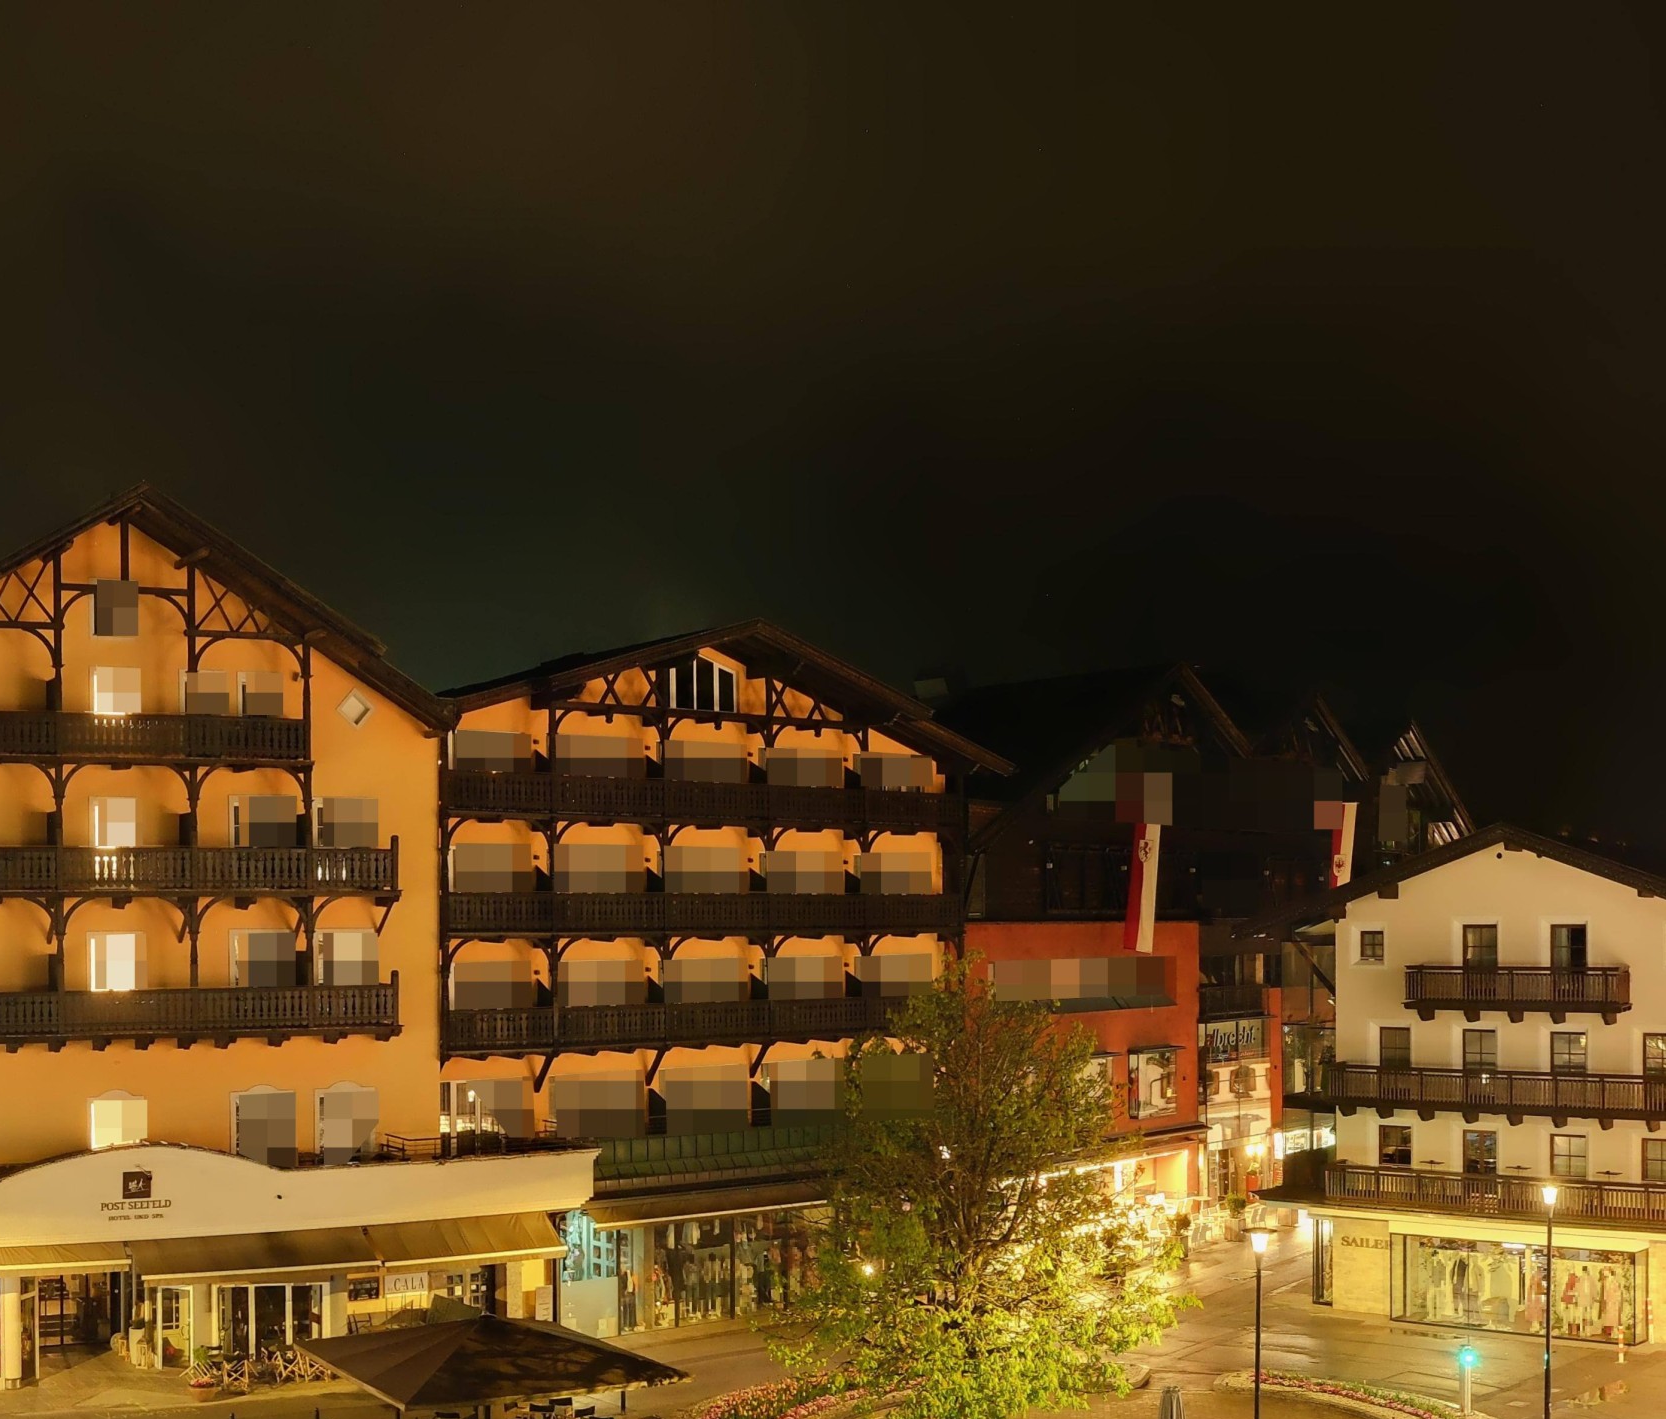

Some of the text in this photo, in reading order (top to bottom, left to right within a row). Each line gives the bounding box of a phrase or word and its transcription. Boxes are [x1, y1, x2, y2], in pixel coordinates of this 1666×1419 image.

[100, 1200, 171, 1211] POST SEEFELD
[394, 1276, 424, 1291] CALA
